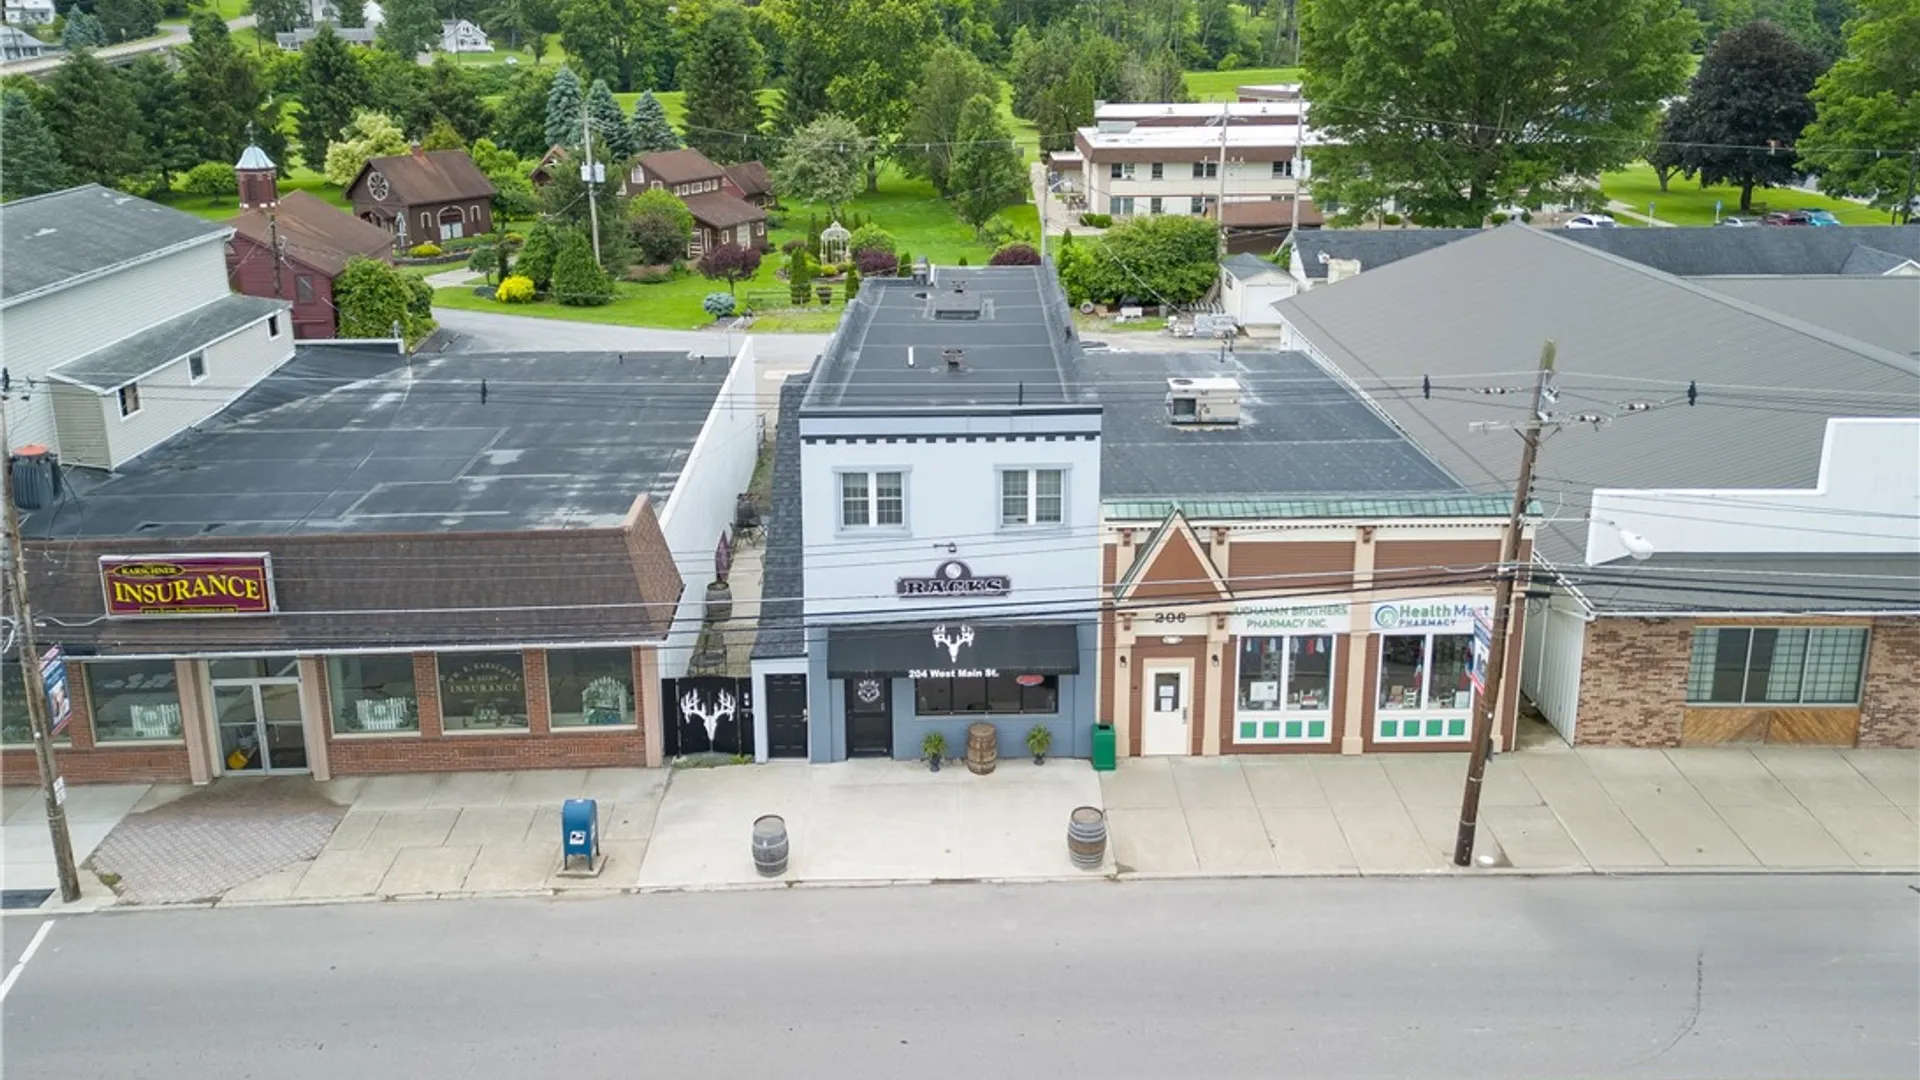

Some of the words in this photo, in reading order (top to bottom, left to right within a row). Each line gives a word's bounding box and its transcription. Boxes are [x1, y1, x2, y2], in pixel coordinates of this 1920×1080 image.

[113, 574, 261, 604] INSURANCE
[904, 579, 1002, 595] RACKS
[1291, 604, 1348, 616] BROTHERS
[1400, 604, 1451, 617] Health
[1453, 604, 1489, 617] Mat
[1155, 611, 1187, 624] 206
[1247, 619, 1304, 629] PHARMACY
[1307, 618, 1329, 629] INC.
[1400, 619, 1456, 628] PHARMACY
[908, 669, 928, 679] 204
[930, 669, 956, 678] West
[958, 668, 983, 678] Main
[985, 667, 999, 678] St.
